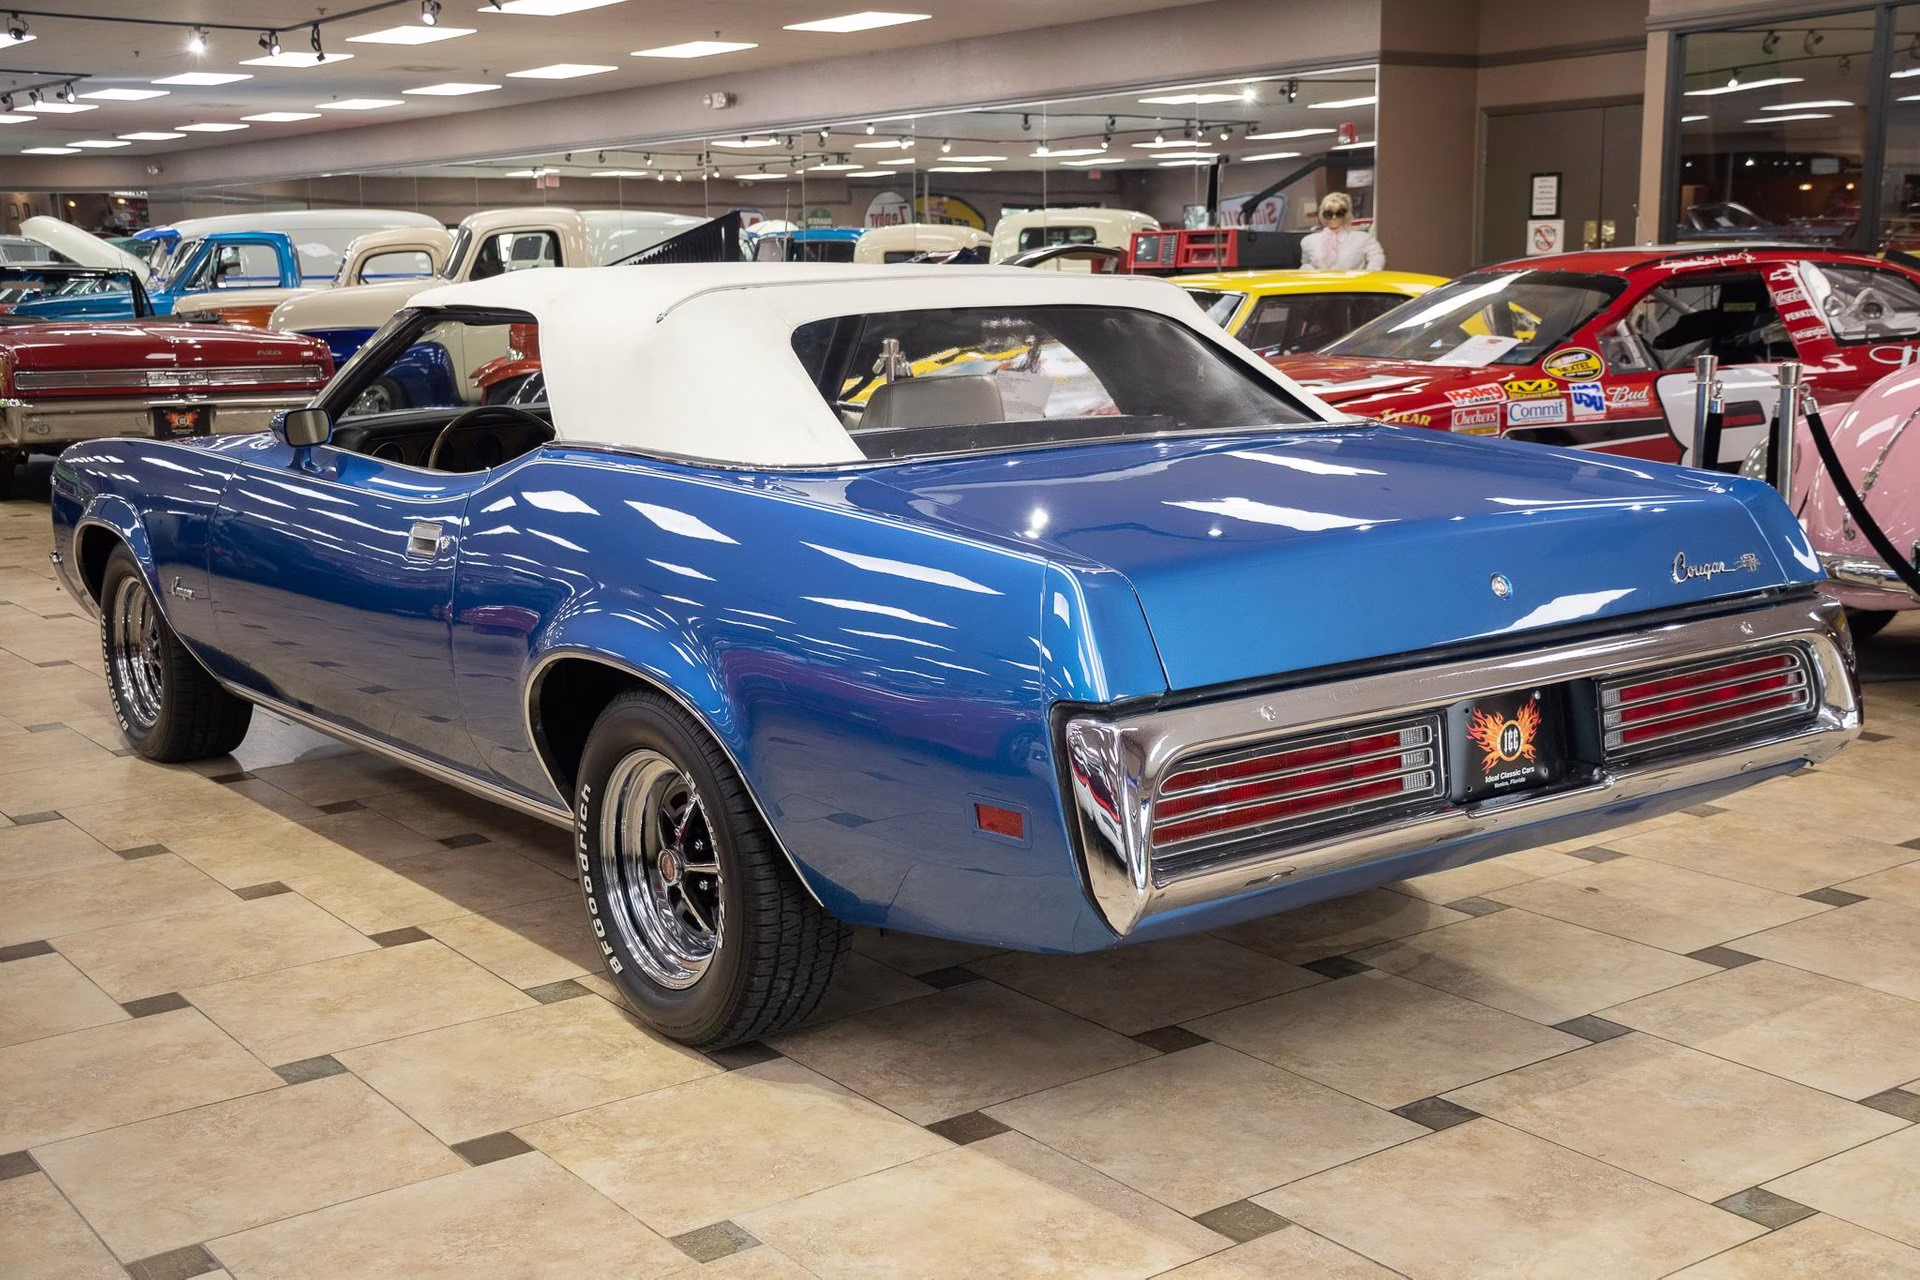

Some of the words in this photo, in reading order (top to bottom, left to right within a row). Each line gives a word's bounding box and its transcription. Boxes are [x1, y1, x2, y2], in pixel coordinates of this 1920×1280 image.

[1448, 385, 1504, 401] Holley
[1606, 385, 1650, 403] Bud
[1454, 410, 1497, 426] Checkers
[1509, 401, 1564, 422] Commit
[1670, 552, 1732, 584] Cougar
[1485, 774, 1500, 784] Ideal
[1500, 769, 1521, 780] Classic
[1521, 766, 1535, 775] Cars
[578, 783, 624, 975] BFGoodrich
